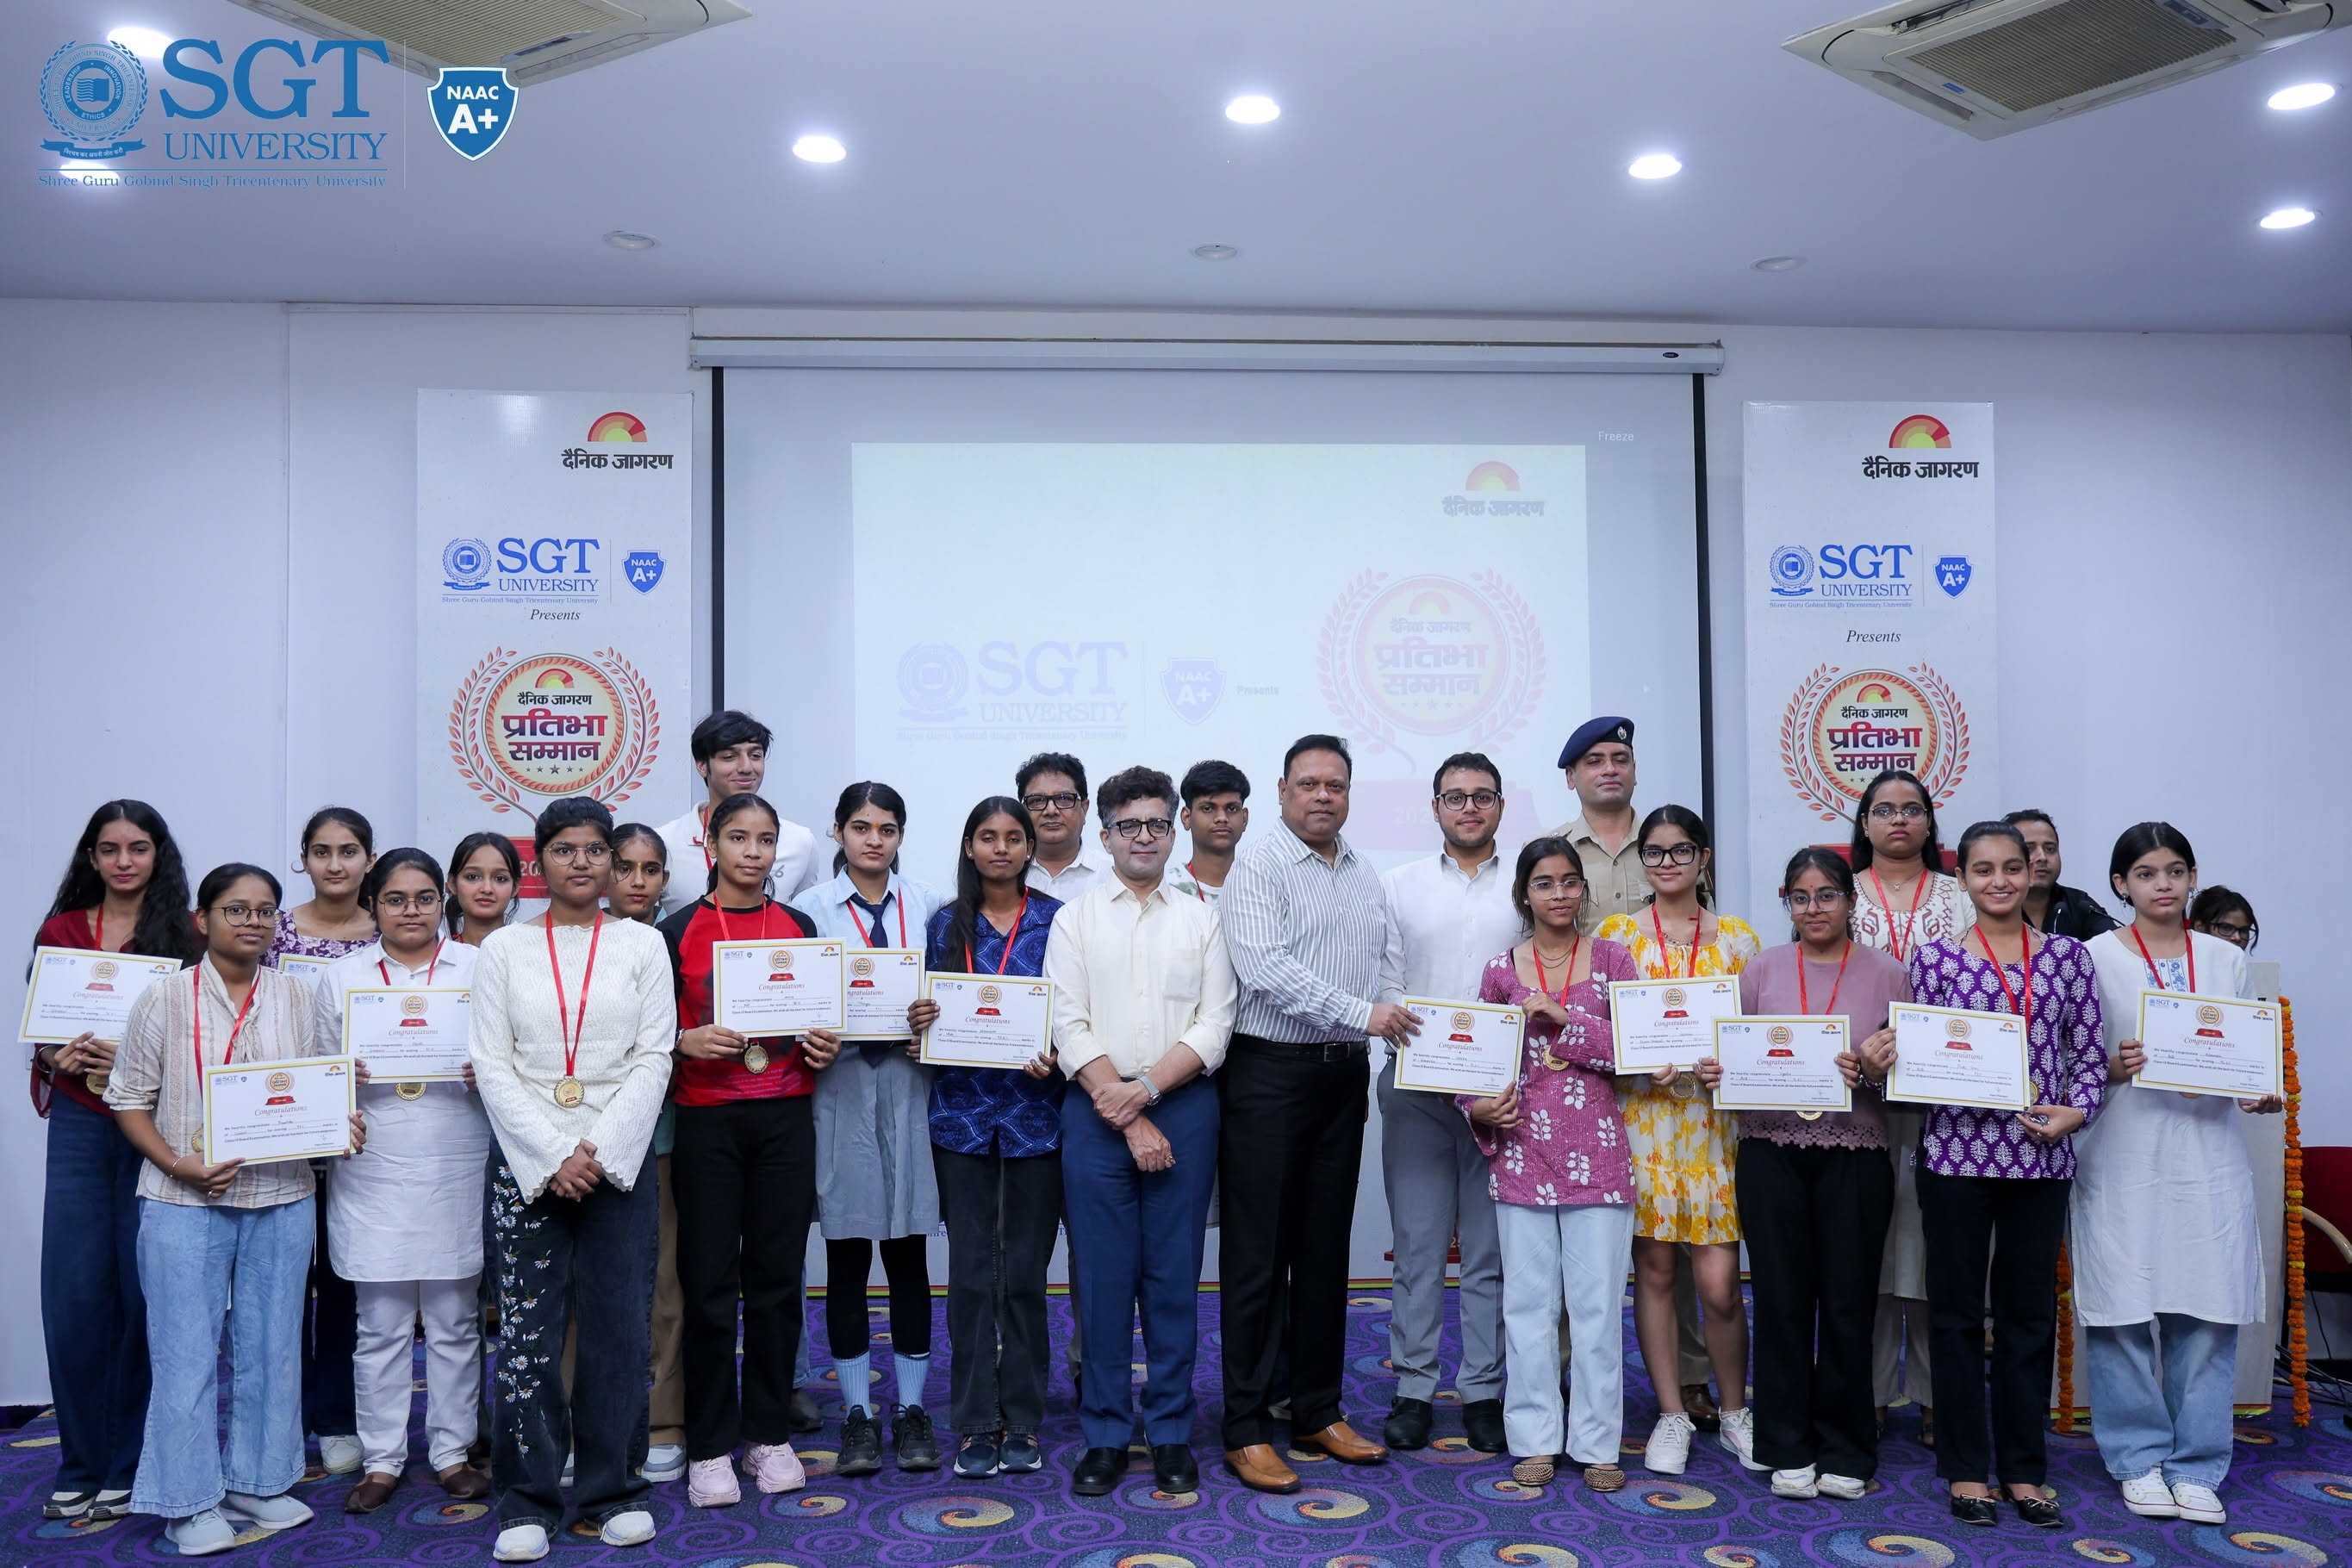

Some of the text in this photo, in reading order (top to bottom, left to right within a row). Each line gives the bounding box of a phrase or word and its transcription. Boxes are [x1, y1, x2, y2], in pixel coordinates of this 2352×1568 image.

[1598, 431, 1634, 441] Freeze
[562, 448, 674, 470] दैनिक जागरण
[1862, 455, 1979, 479] दैनिक जागरण
[496, 538, 600, 574] SGT
[1819, 544, 1913, 580] SGT
[632, 567, 656, 582] A+
[1943, 572, 1965, 587] A+
[498, 578, 600, 593] UNIVERSITY
[1820, 583, 1913, 597] UNIVERSITY
[531, 609, 581, 620] Presents
[1846, 630, 1901, 643] Presents
[976, 641, 1130, 696] SGT
[1174, 672, 1212, 682] NAAC
[517, 691, 592, 706] दैनिक जागरण
[1177, 685, 1212, 706] A+
[980, 703, 1127, 724] UNIVERSITY
[1841, 706, 1908, 719] दैनिक जागरण
[501, 708, 608, 739] प्रतिभा
[1826, 721, 1923, 751] प्रतिभा
[508, 741, 601, 762] सम्मान
[1833, 753, 1916, 772] सम्मान
[758, 981, 805, 992] Congratulations
[965, 1015, 1010, 1024] Congratulations
[1653, 1018, 1699, 1028] Congratulations
[389, 1027, 438, 1036] Congratulations
[1438, 1041, 1482, 1052] Congratulations
[2184, 1036, 2234, 1048] Congratulations
[1934, 1048, 1982, 1061] Congratulations
[1757, 1057, 1804, 1067] Congratulations
[254, 1104, 307, 1117] Congratulations
